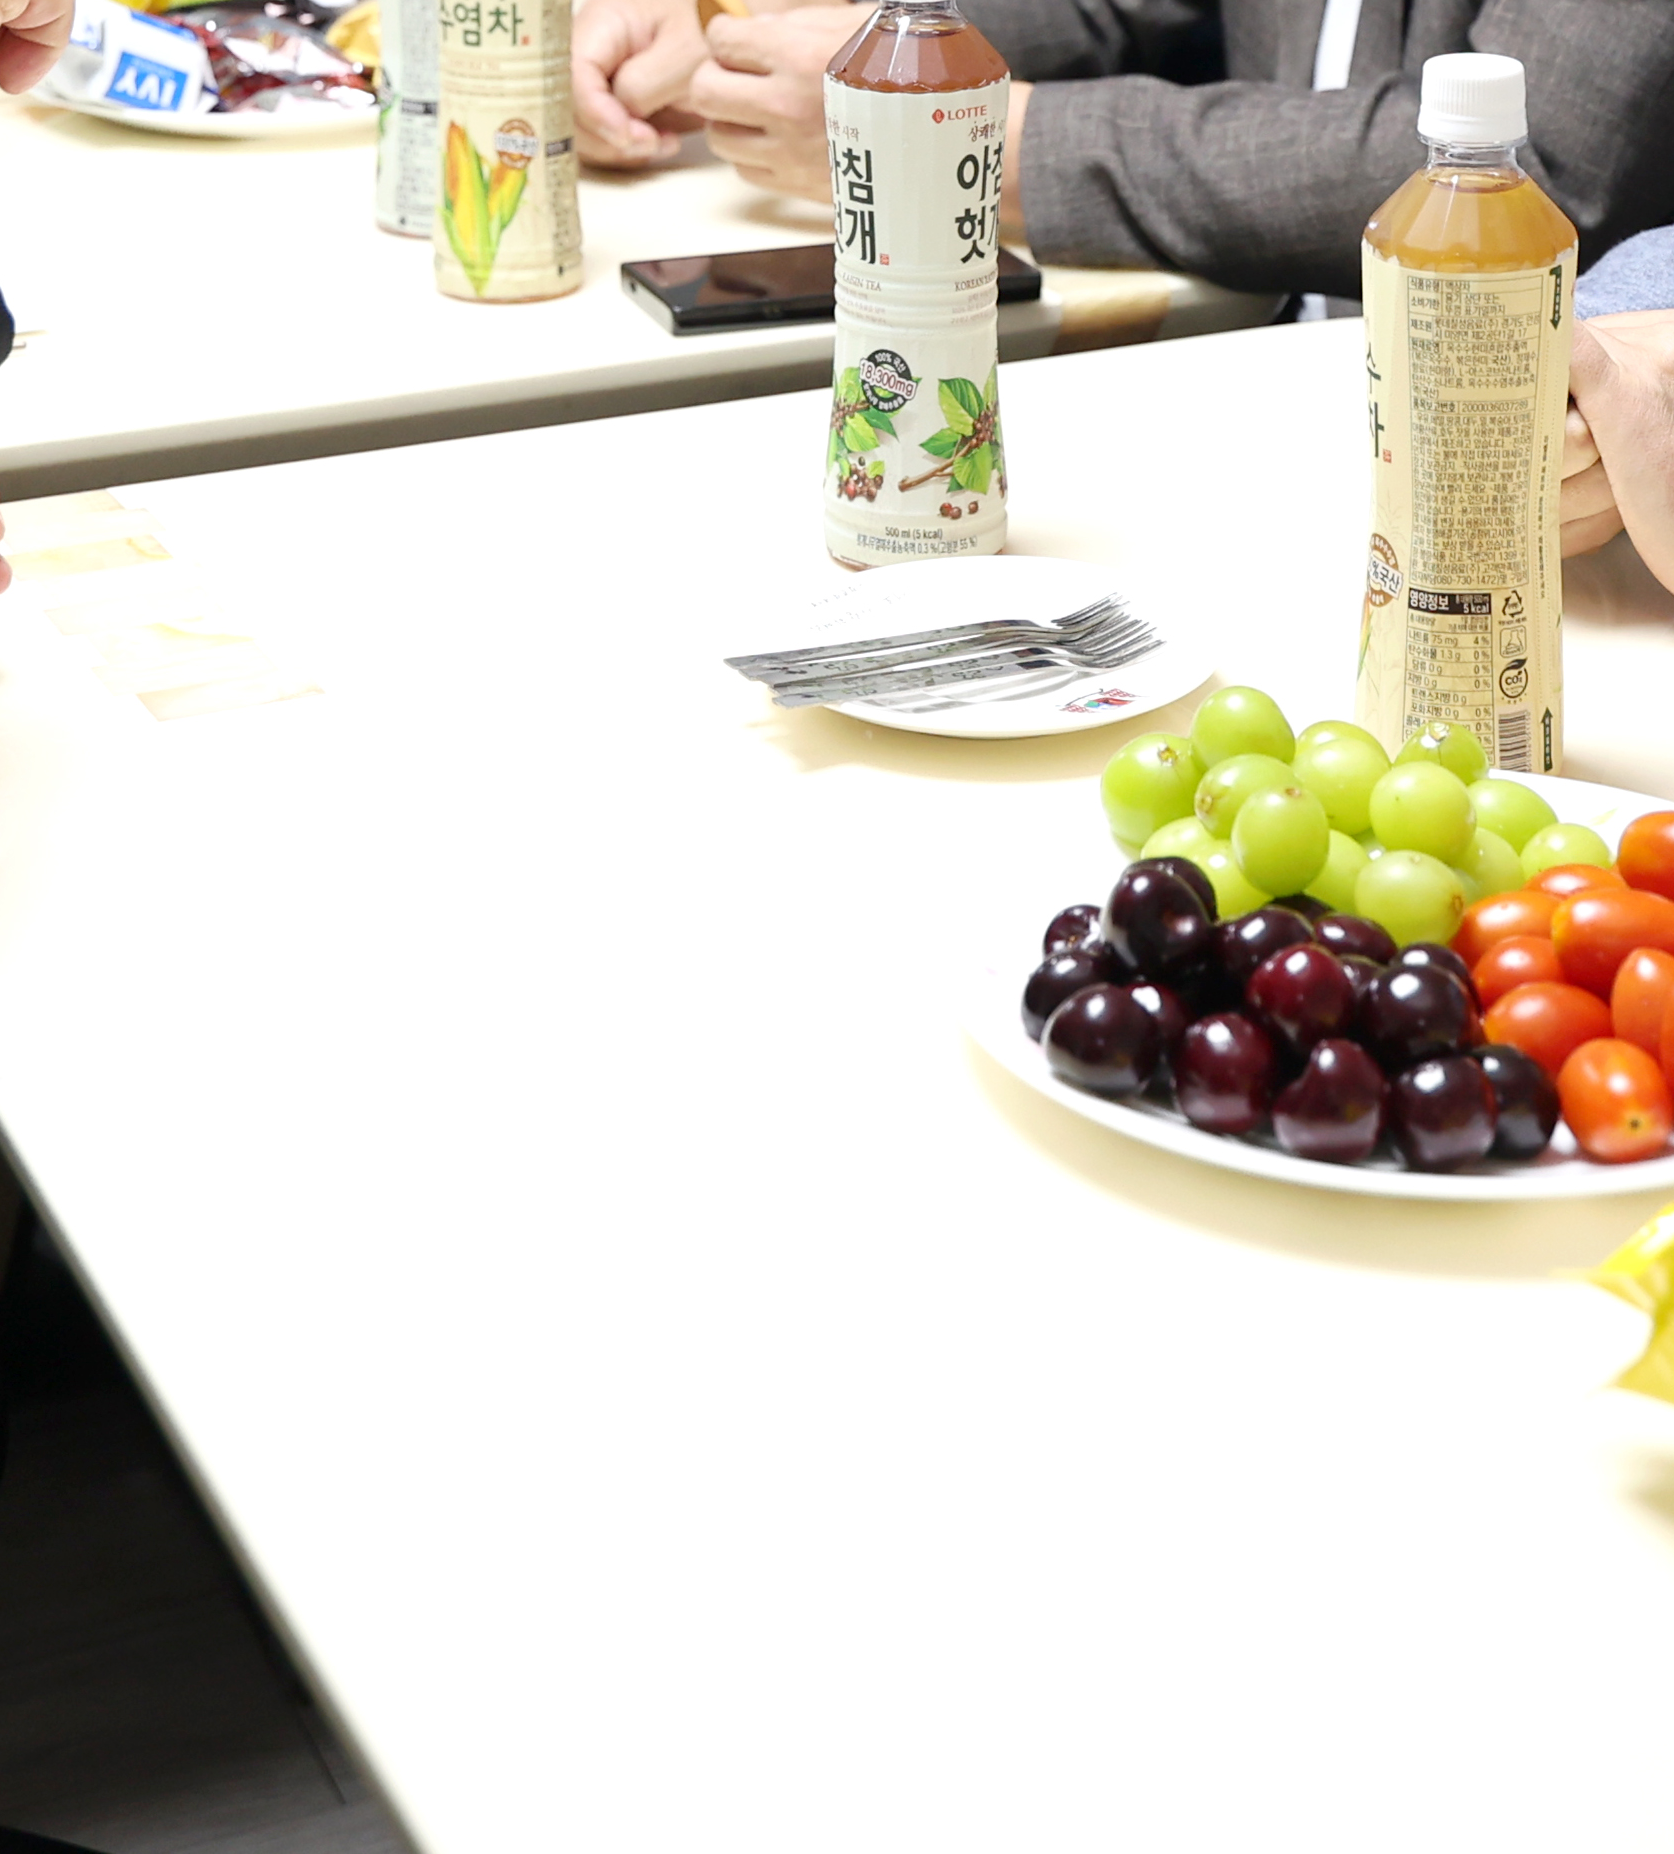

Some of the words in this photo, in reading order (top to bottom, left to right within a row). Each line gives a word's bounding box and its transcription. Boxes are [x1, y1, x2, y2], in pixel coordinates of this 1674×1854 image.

[115, 62, 177, 108] IVY
[948, 105, 987, 120] LOTTE
[957, 141, 1005, 201] 아침
[865, 281, 881, 291] TEA
[955, 278, 984, 292] KOREAN
[1410, 277, 1440, 292] 식품유형
[1411, 296, 1440, 309] 소비기한
[1465, 294, 1481, 304] 상단
[1484, 295, 1499, 304] 또는
[1465, 305, 1505, 316] 표기일까지
[1411, 319, 1432, 331] 제조원
[1435, 318, 1499, 329] 롯데칠성음료(주)
[1501, 318, 1523, 328] 경기도
[1435, 330, 1442, 339] 시
[1518, 328, 1527, 338] 17
[861, 362, 914, 397] 18,300mg
[885, 527, 899, 537] 500
[901, 530, 910, 538] ml
[913, 529, 921, 540] (5
[923, 528, 943, 540] kcal)
[1410, 591, 1449, 610] 영양정보
[1464, 604, 1469, 613] 5
[1471, 603, 1489, 613] kcal
[1409, 628, 1429, 644] 나트륨
[1432, 634, 1442, 644] 75
[1445, 638, 1458, 647] mg
[1474, 636, 1479, 645] 4
[1481, 635, 1490, 645] %
[1409, 644, 1437, 659] 탄수화물
[1474, 650, 1479, 660] 0
[1481, 651, 1490, 659] %
[1412, 660, 1426, 671] 당류
[1474, 664, 1480, 674] 0
[1482, 665, 1490, 674] %
[1407, 672, 1421, 685] 지방
[1474, 679, 1480, 689] 0
[1482, 680, 1490, 688] %
[1412, 689, 1451, 703] 트랜스지방
[1411, 702, 1443, 717] 포화지방
[1476, 708, 1482, 717] 0
[1483, 708, 1491, 717] %
